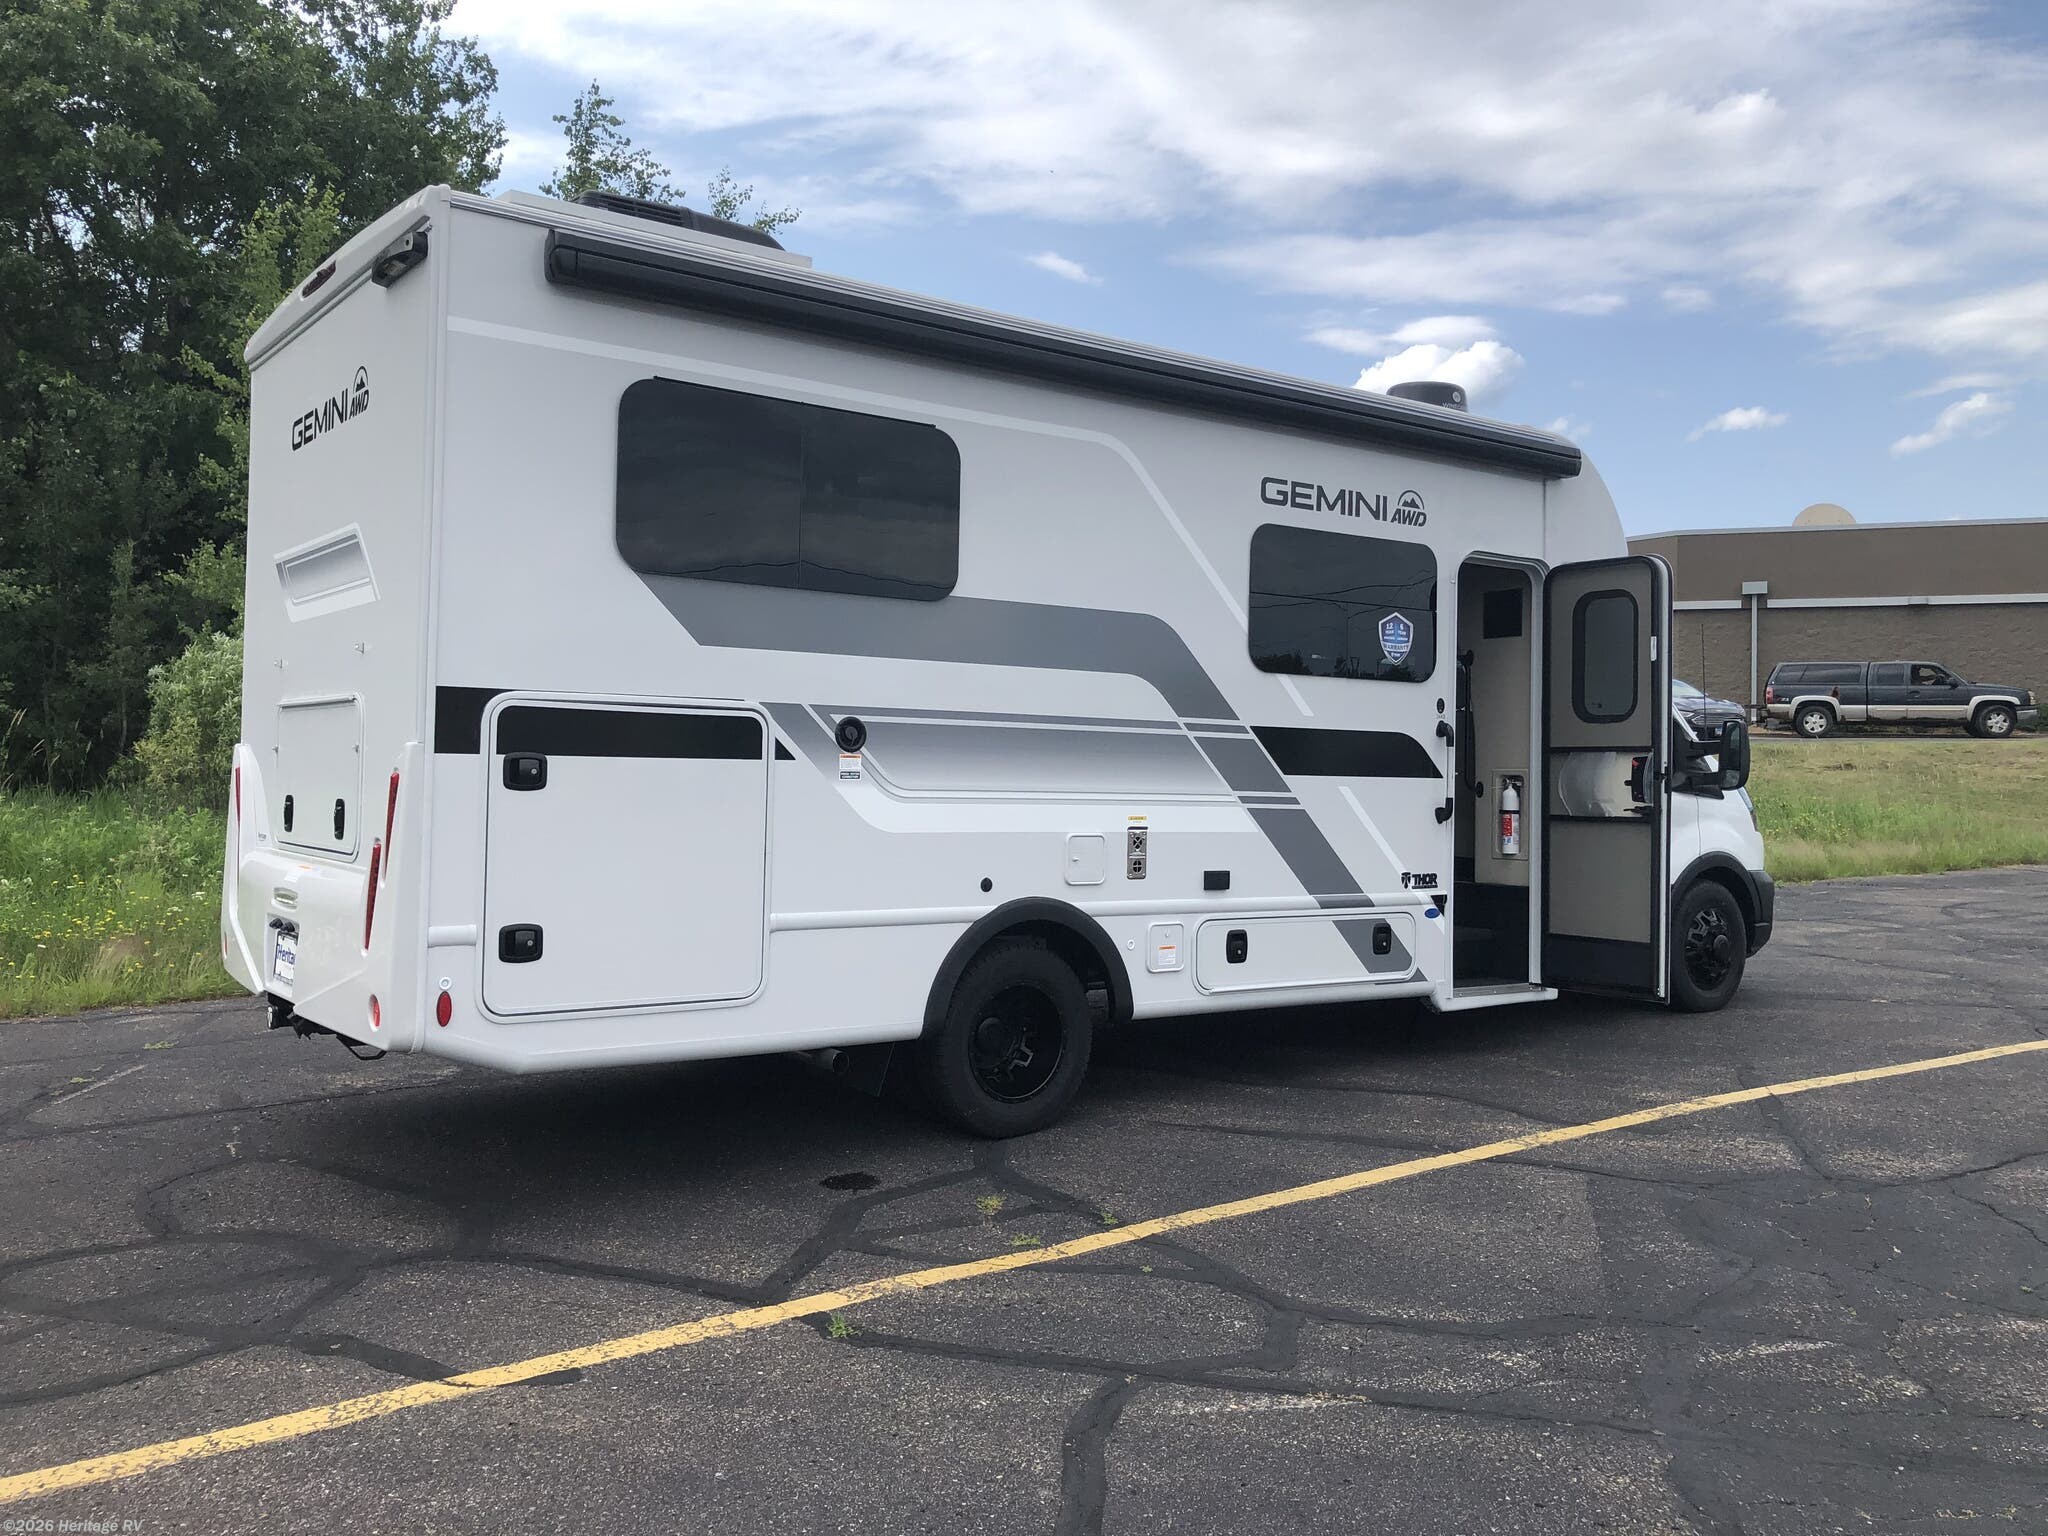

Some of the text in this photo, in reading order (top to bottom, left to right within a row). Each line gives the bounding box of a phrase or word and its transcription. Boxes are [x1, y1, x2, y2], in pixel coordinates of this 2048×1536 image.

[291, 387, 370, 452] GEMINI AWD
[1260, 476, 1427, 527] GEMINI AWD
[1411, 872, 1438, 886] THOR
